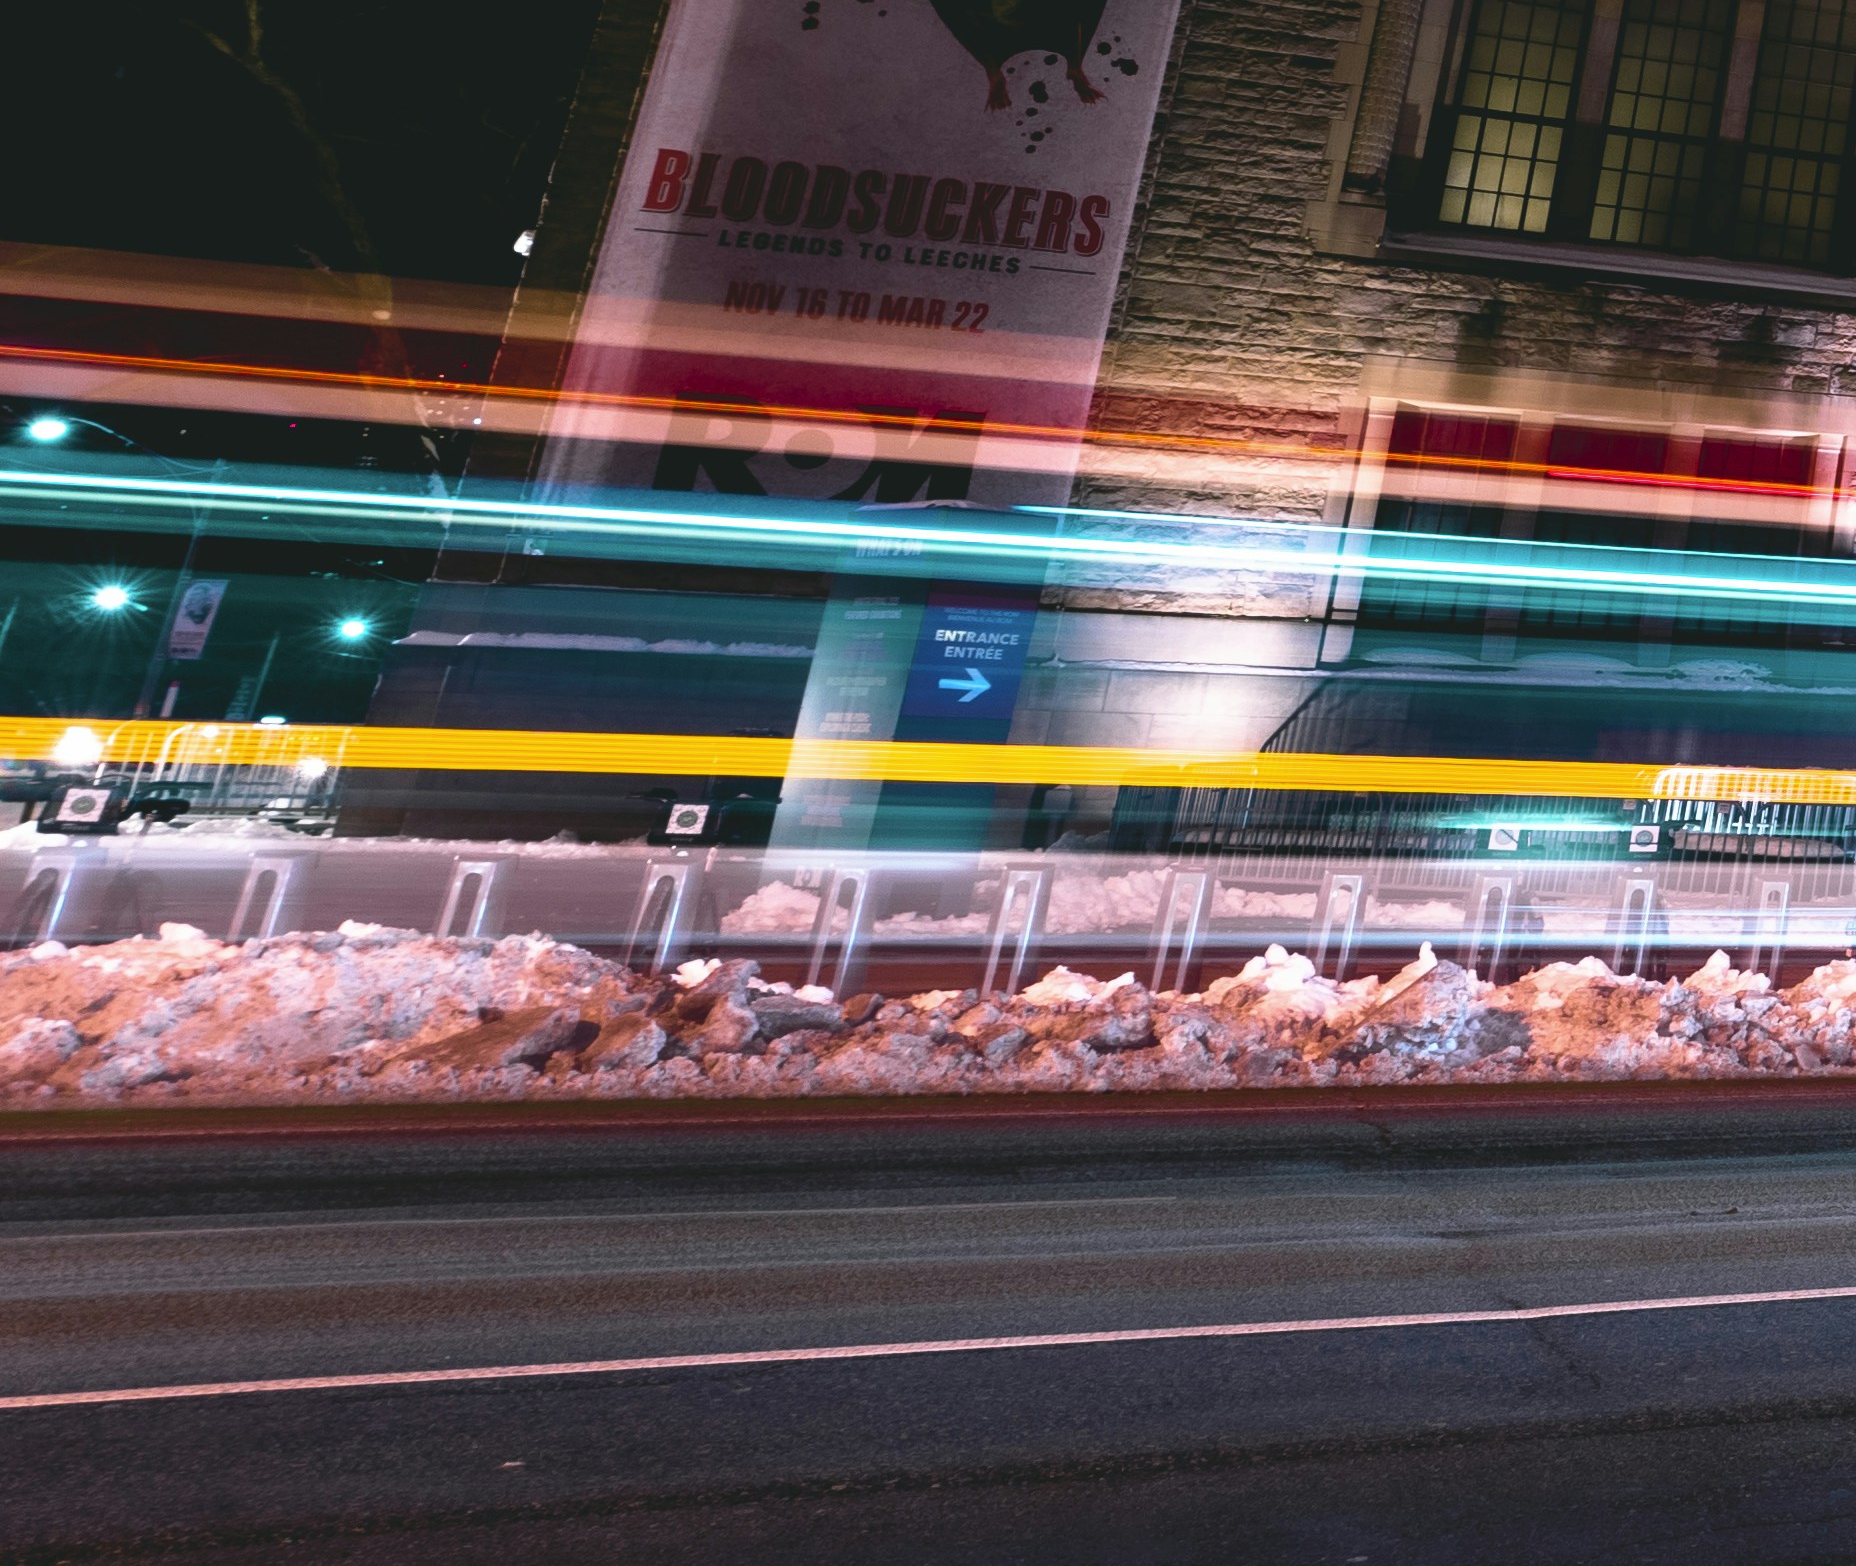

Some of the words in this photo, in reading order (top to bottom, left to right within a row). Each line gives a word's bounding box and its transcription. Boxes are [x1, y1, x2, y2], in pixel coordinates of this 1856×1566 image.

[639, 147, 1111, 258] BLOODSUCKERS
[717, 229, 845, 258] LEGENDS
[858, 243, 893, 263] TO
[904, 246, 1021, 275] LEECHES
[723, 280, 788, 317] NOV
[794, 287, 829, 321] 16
[837, 290, 872, 324] TO
[875, 293, 948, 331] MAR
[950, 300, 991, 334] 22
[934, 628, 1021, 645] ENTRANCE
[944, 644, 1004, 660] ENTRÉE
